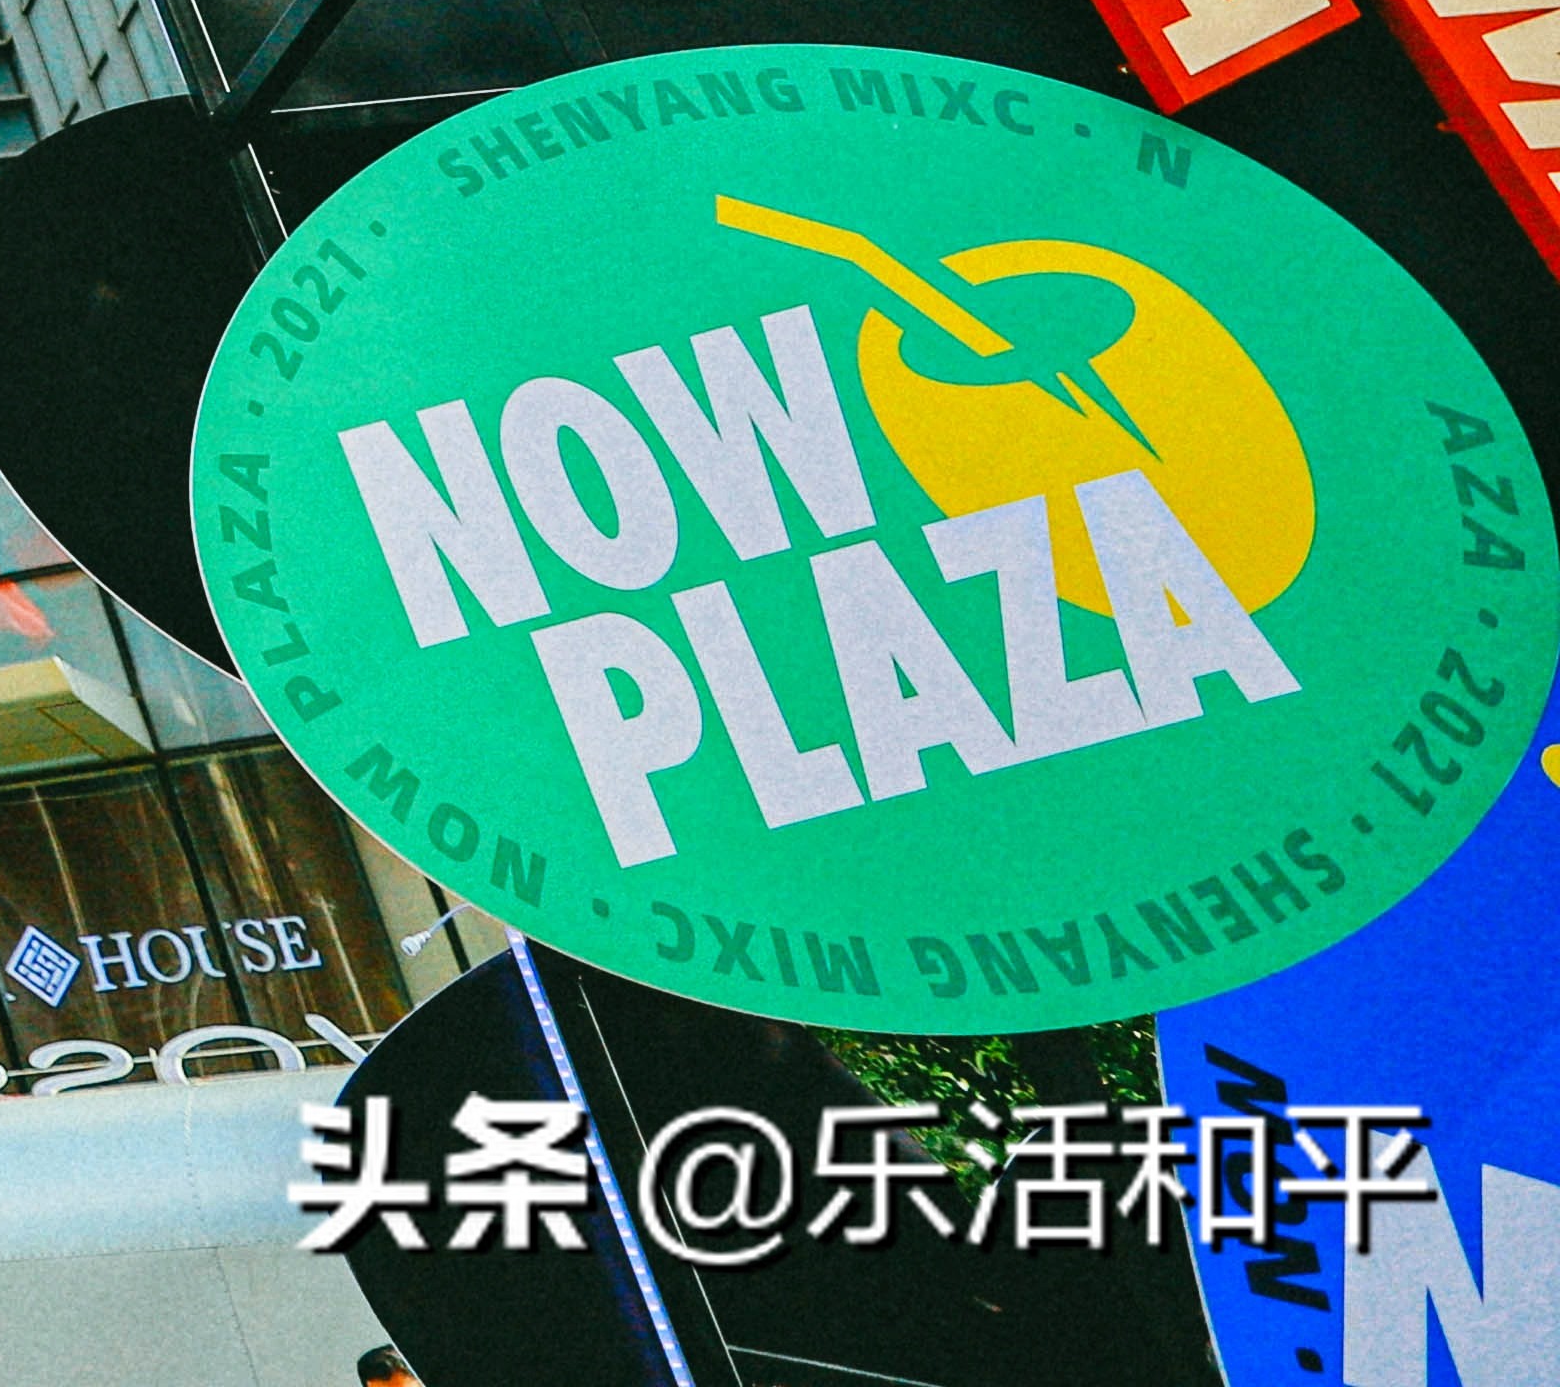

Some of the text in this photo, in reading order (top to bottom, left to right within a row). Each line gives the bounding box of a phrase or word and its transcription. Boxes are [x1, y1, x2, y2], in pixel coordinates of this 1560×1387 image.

[438, 65, 803, 196] SHENYANG
[837, 67, 1035, 136] MIXC
[253, 238, 368, 382] 2021
[337, 303, 876, 648] NOW
[221, 449, 340, 724] PLAZA
[531, 468, 1303, 870] PLAZA
[1372, 646, 1506, 817] 2021
[348, 744, 550, 907] NOW
[79, 915, 322, 993] HOUSE
[651, 896, 874, 997] MIXC
[921, 828, 1346, 999] SHENYANG
